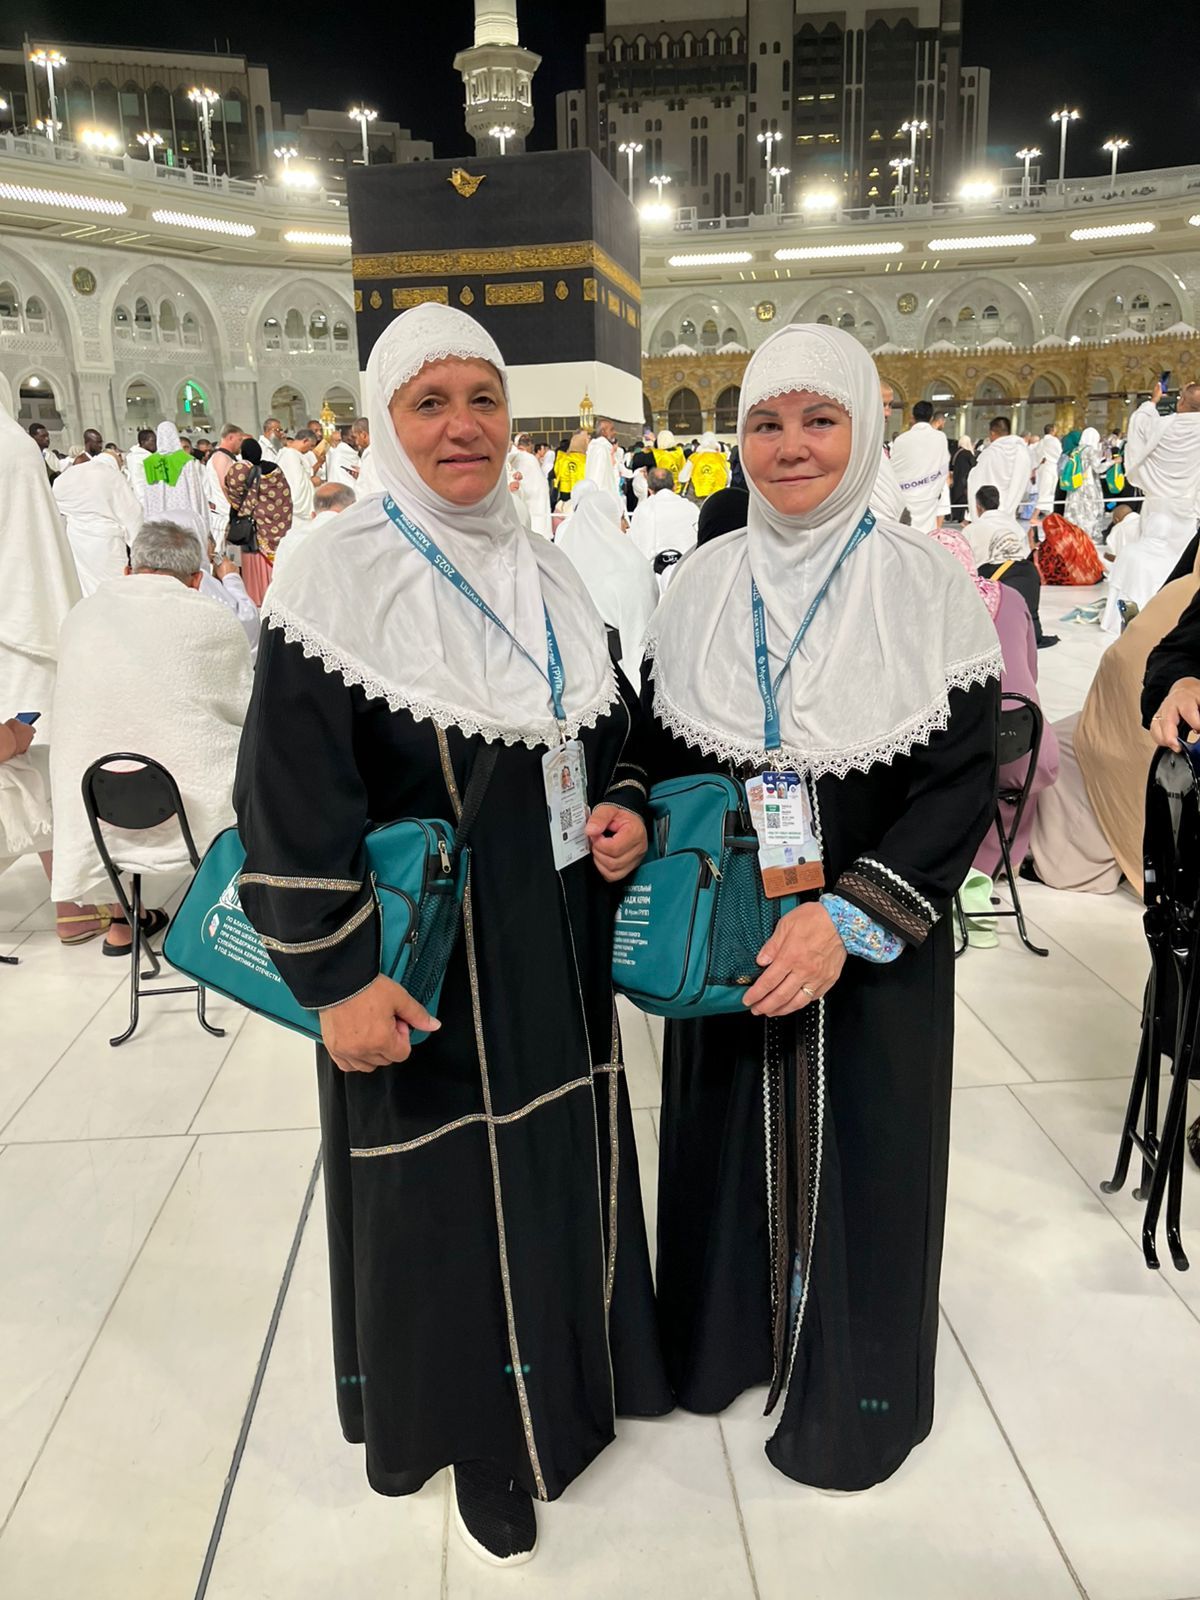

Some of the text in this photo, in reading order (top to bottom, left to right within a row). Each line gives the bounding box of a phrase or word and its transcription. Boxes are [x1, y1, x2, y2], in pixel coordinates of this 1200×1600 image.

[433, 554, 456, 577] 2025
[226, 915, 234, 923] ПО
[217, 937, 268, 967] СУЛЕЙМАНА КЕРИМОВА
[220, 930, 230, 938] ПРИ
[229, 934, 257, 951] ПОДДЕРЖКЕ
[217, 946, 228, 955] ГОД
[228, 952, 255, 968] ЗАЩИТНИКА
[254, 966, 281, 982] ОТЕЧЕСТВА
